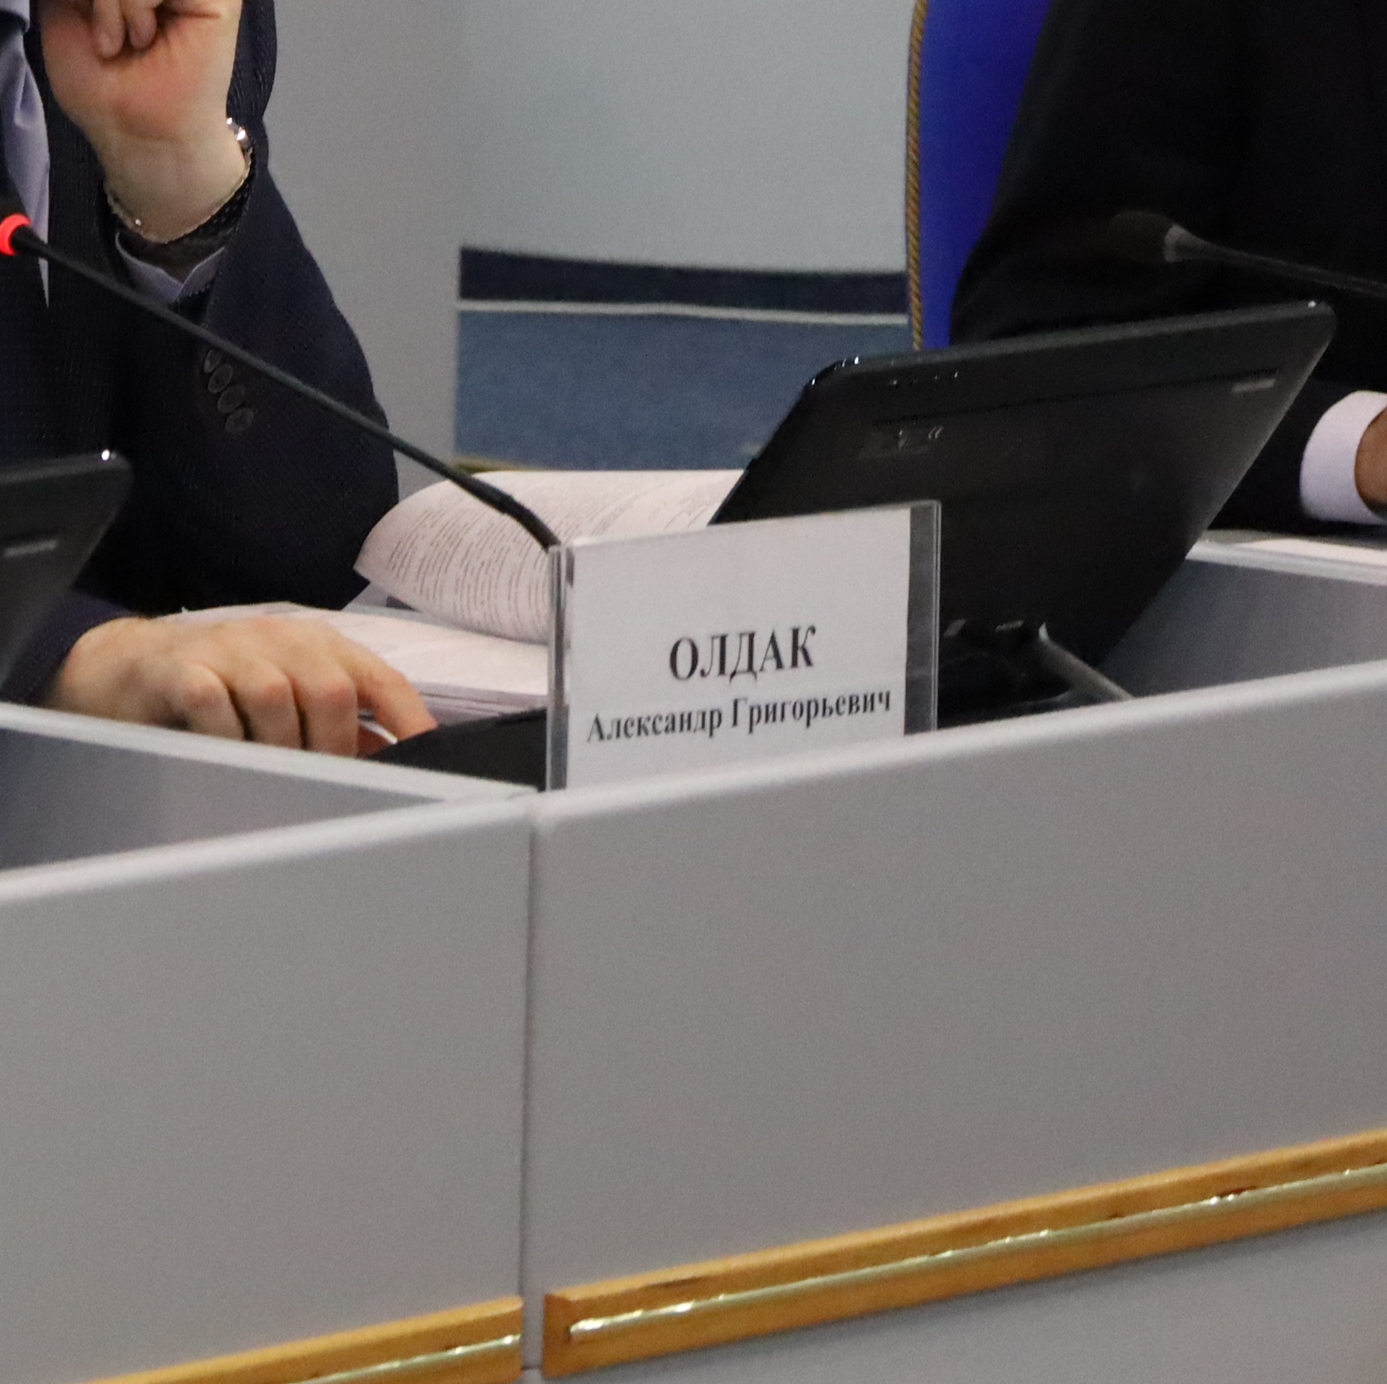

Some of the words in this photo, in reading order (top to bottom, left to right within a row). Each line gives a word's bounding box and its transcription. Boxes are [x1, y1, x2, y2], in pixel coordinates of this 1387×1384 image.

[669, 624, 816, 683] ОЛДАК
[586, 706, 723, 744] Александр
[731, 689, 891, 734] Григорьевич
